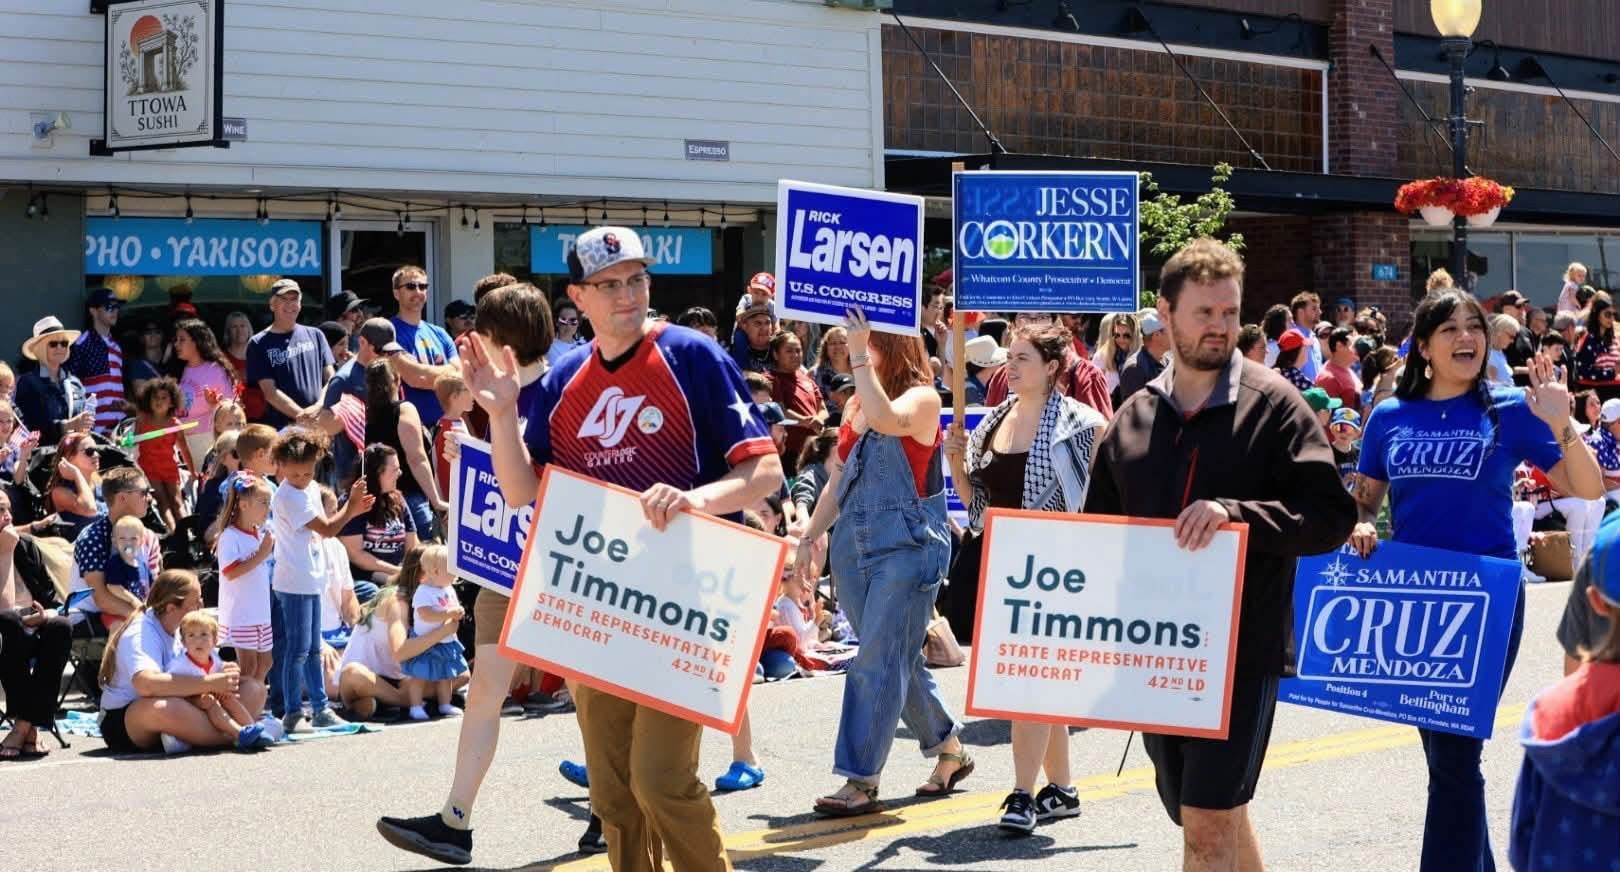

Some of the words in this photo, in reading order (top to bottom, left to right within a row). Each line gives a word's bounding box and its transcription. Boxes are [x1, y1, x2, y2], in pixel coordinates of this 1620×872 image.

[127, 95, 187, 116] TTOWA
[137, 114, 178, 131] SUSHI
[1036, 187, 1131, 217] JESSE
[809, 210, 841, 224] RICK
[789, 209, 915, 284] Larsen
[959, 219, 1132, 260] CORKERN
[167, 236, 321, 269] YAKISOBA
[971, 274, 1010, 284] Whatcom
[1012, 274, 1042, 286] County
[1045, 274, 1088, 284] Prosecutor
[789, 281, 817, 295] U.S.
[819, 285, 913, 309] CONGRESS
[1415, 429, 1482, 438] SAMANTHA
[1390, 440, 1479, 466] CRUZ
[479, 470, 498, 487] RIC
[1398, 465, 1472, 476] MENDOZA
[461, 466, 536, 550] Lars
[461, 541, 487, 560] U.S.
[555, 514, 629, 563] Joe
[1006, 554, 1086, 593] Joe
[1356, 568, 1482, 588] SAMANTHA
[549, 550, 731, 642] Timmons
[532, 609, 613, 646] DEMOCRAT
[537, 592, 585, 618] STATE
[590, 611, 732, 667] REPRESENTATIVE
[1003, 598, 1201, 649] Timmons
[1313, 595, 1475, 666] CRUZ
[998, 643, 1049, 660] STATE
[1057, 648, 1208, 673] REPRESENTATIVE
[1331, 656, 1466, 681] MENDOZA
[708, 670, 727, 684] LD
[996, 662, 1082, 682] DEMOCRAT
[1187, 677, 1206, 691] LD
[1325, 683, 1361, 697] Position
[1362, 689, 1368, 698] 4
[1429, 690, 1453, 704] Port
[1455, 696, 1469, 705] of
[1400, 693, 1470, 717] Bellingham
